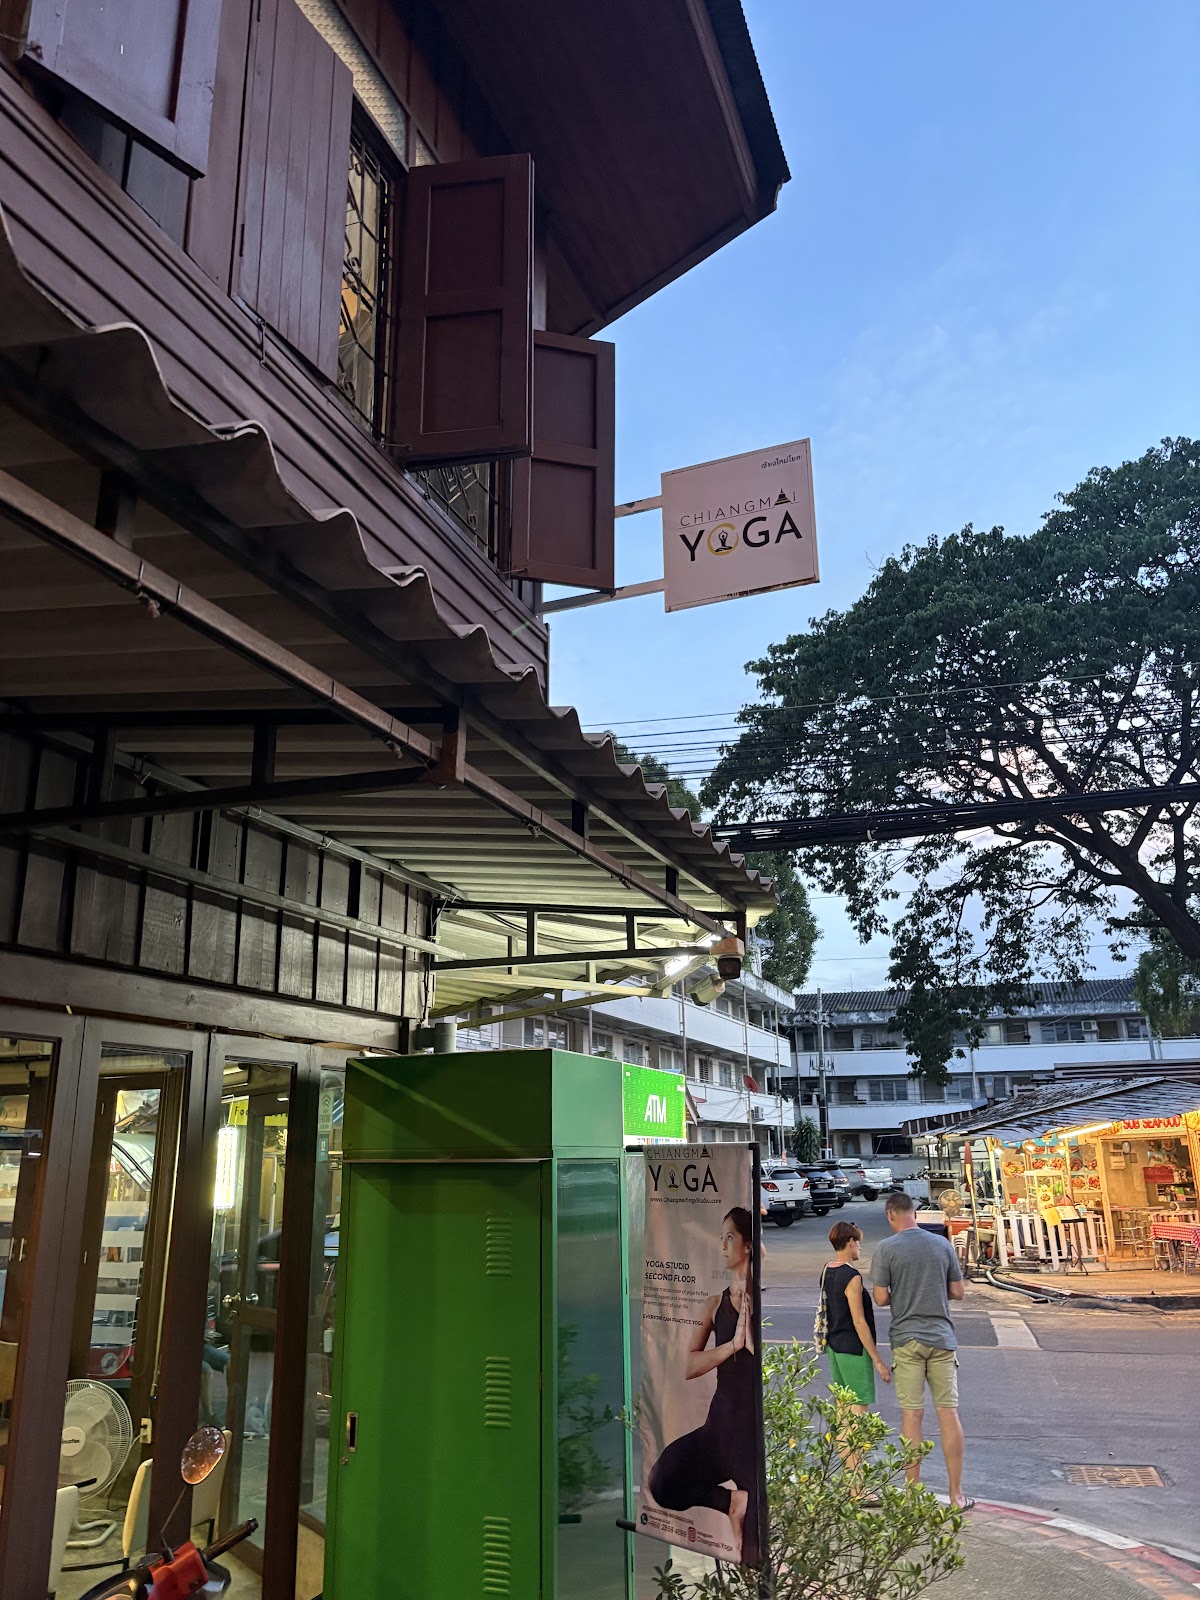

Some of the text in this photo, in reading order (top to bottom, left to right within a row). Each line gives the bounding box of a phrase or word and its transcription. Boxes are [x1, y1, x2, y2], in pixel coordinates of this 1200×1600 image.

[679, 510, 803, 562] YOGA
[644, 1094, 667, 1124] ATM
[648, 1163, 719, 1193] YOGA
[645, 1260, 690, 1271] YOGA STUDIO
[644, 1272, 696, 1284] SECOND FLOOR
[672, 1317, 692, 1325] PRACTICE
